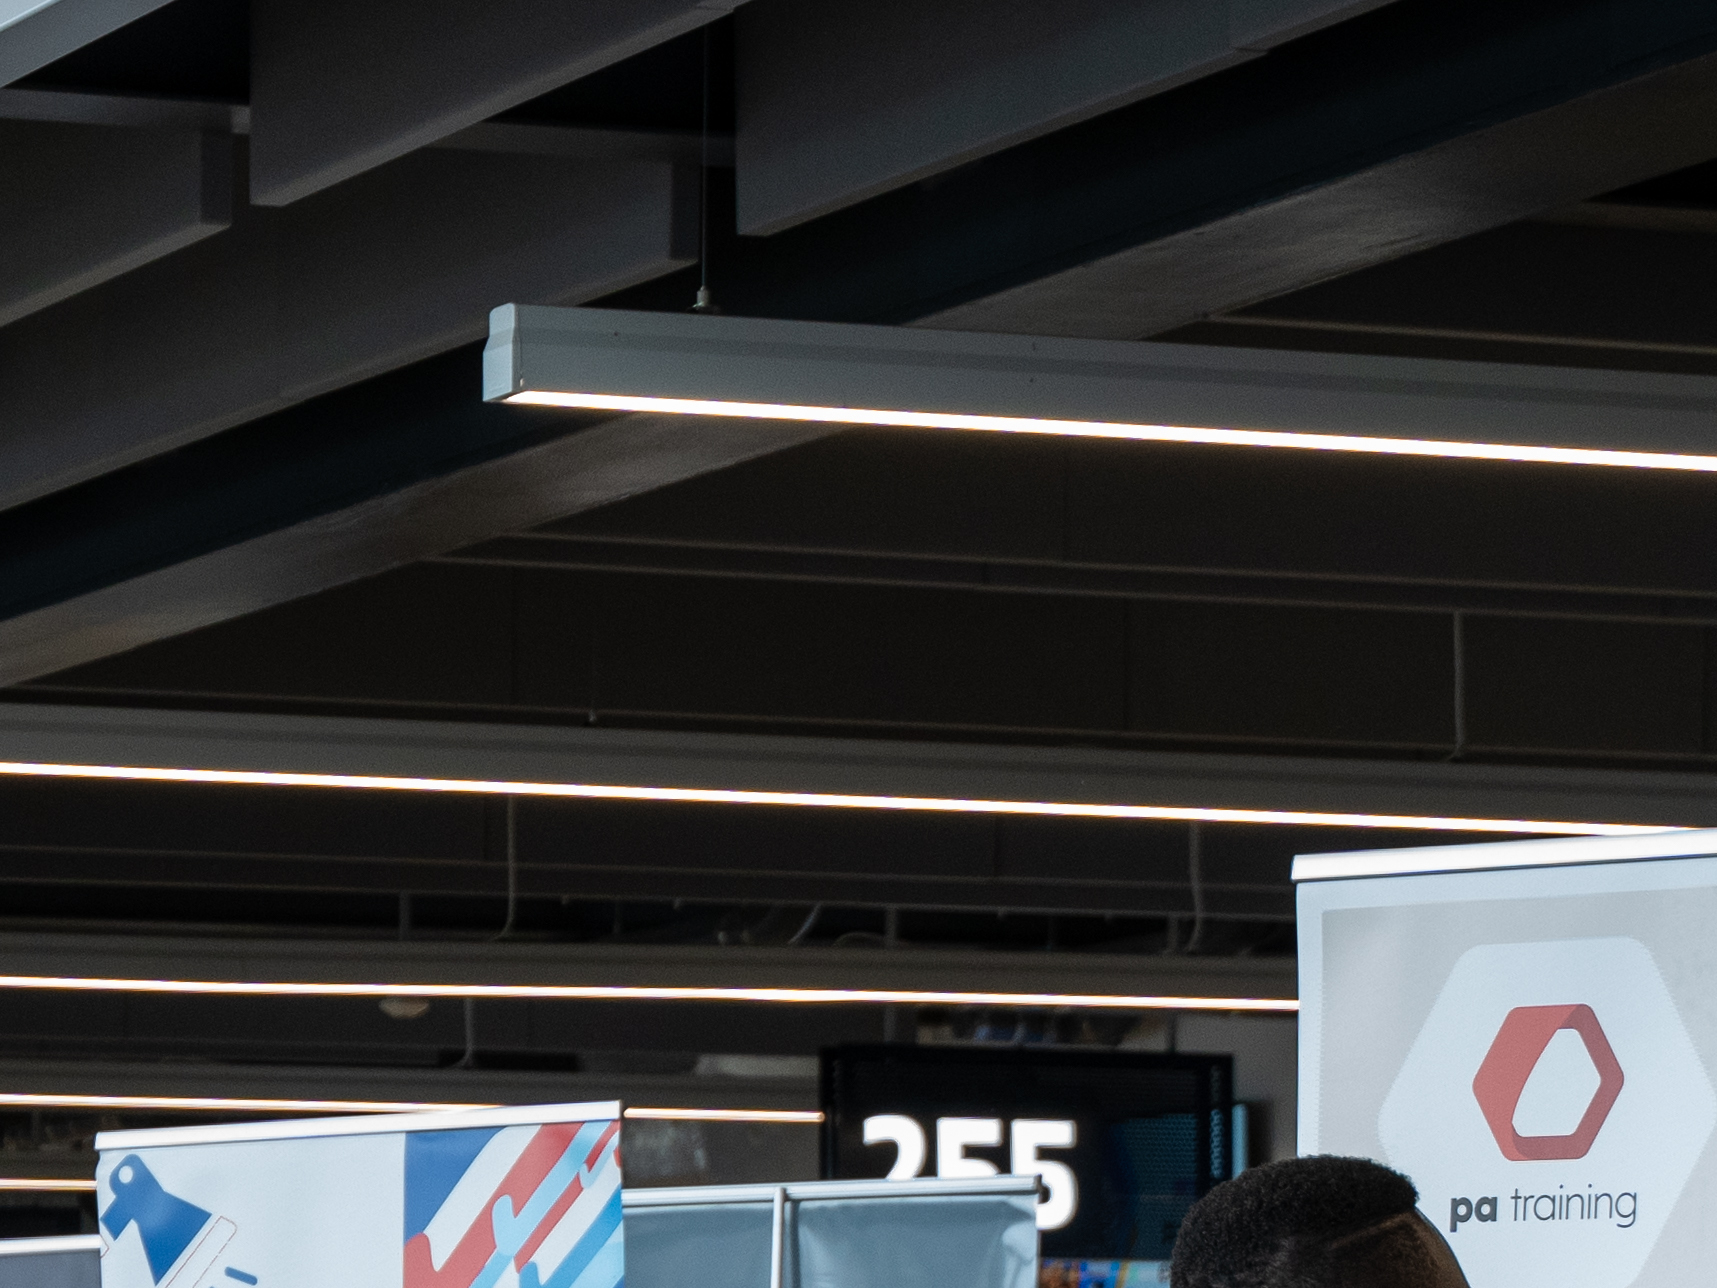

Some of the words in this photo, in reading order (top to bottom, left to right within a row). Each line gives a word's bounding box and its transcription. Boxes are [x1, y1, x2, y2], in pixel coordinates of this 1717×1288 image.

[862, 1113, 1078, 1231] 255
[1449, 1195, 1498, 1233] pa
[1510, 1183, 1638, 1229] training
